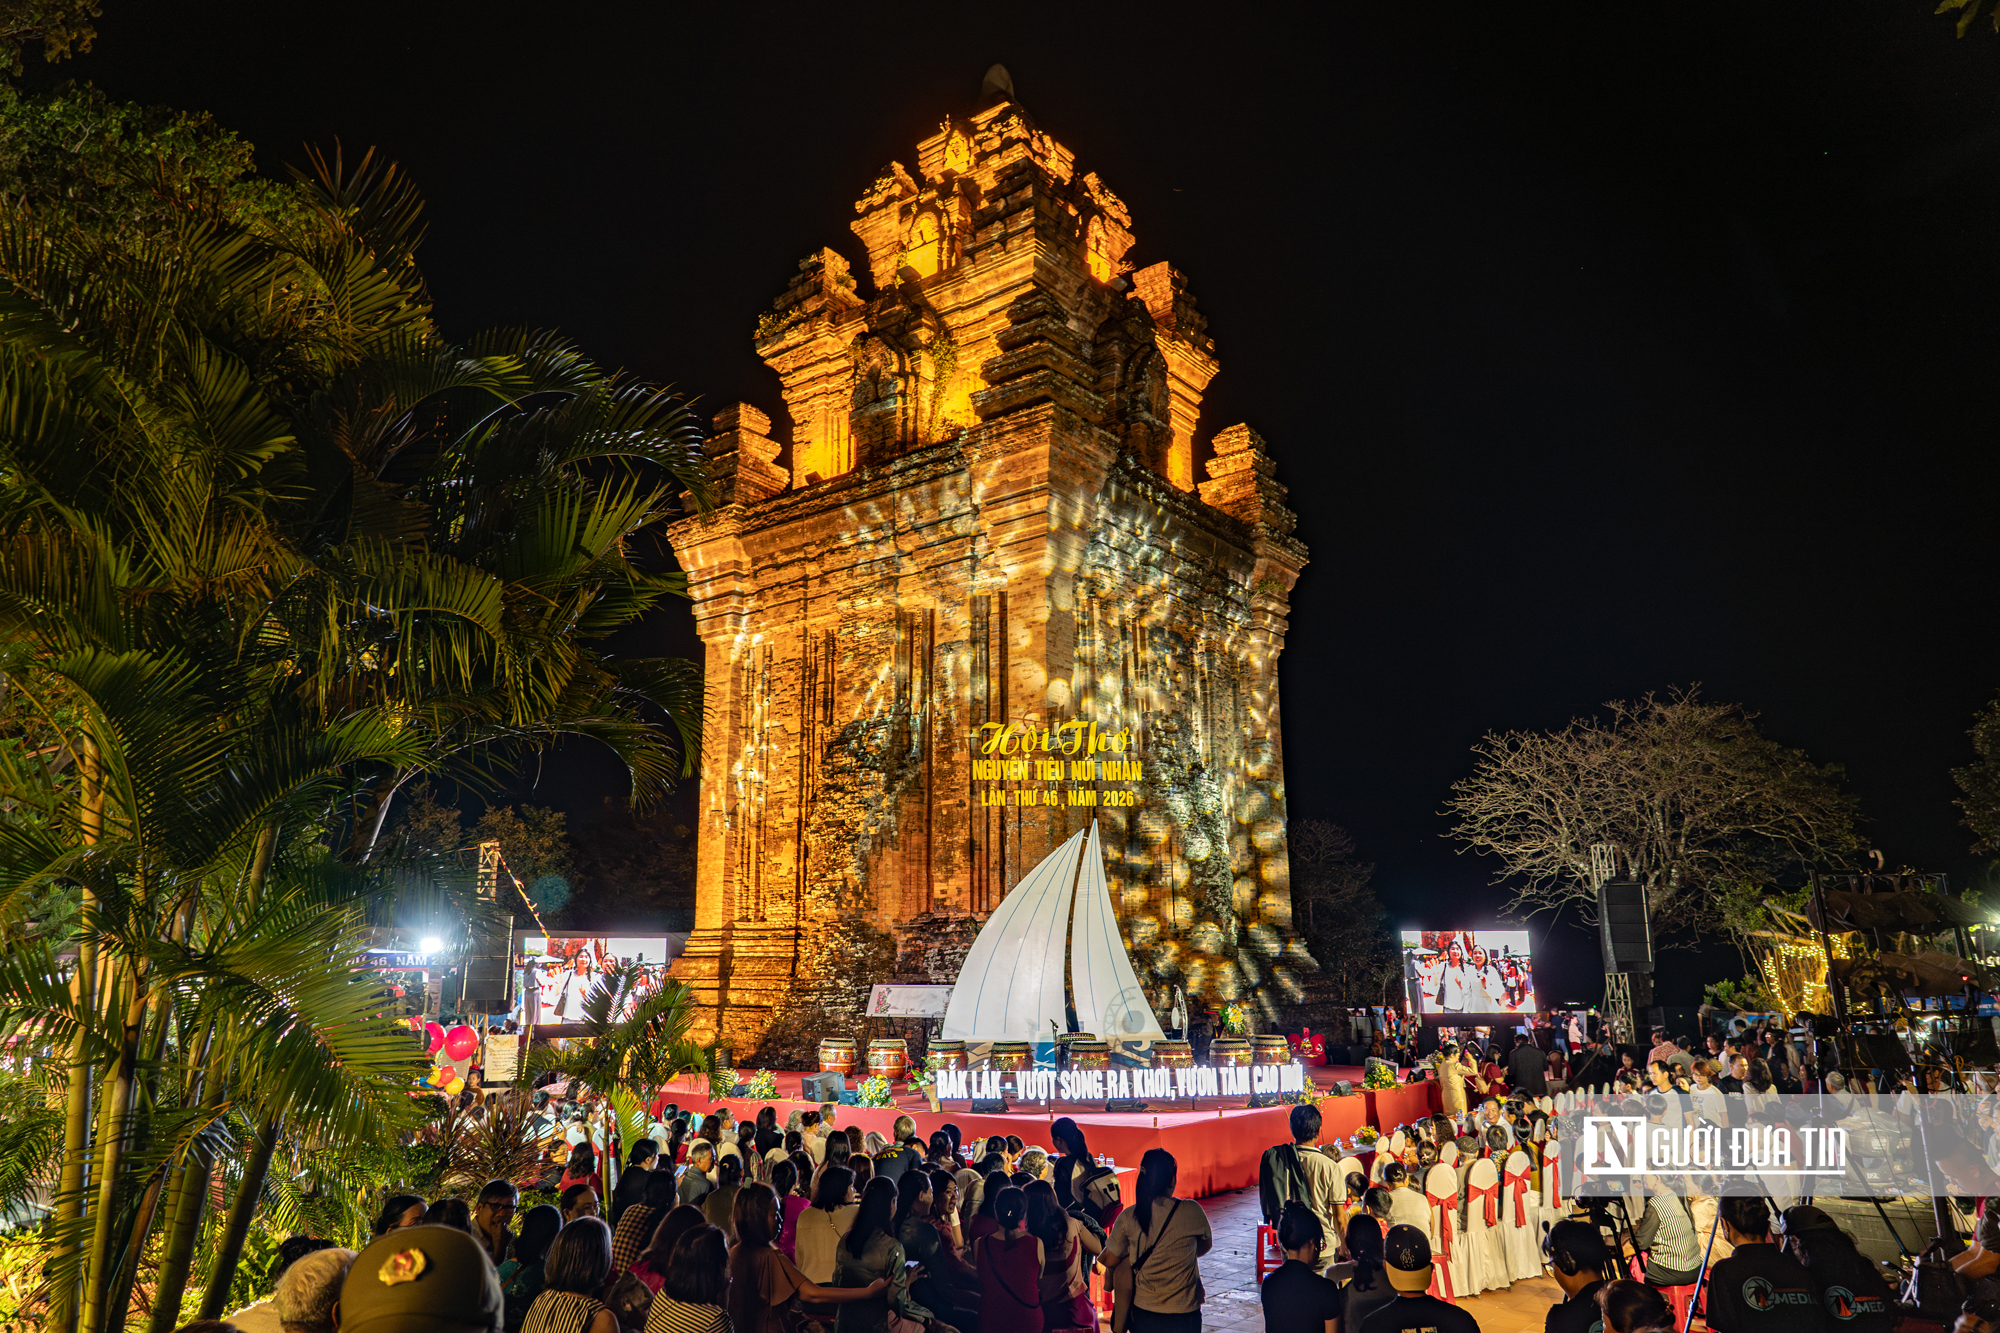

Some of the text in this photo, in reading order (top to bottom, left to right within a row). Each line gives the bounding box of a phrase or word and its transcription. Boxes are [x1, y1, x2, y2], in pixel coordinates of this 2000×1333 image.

[980, 721, 1132, 758] Hội Thơ
[973, 756, 1142, 785] NGUYÊN TIÊU NÚI NHẠN
[981, 784, 1006, 807] LẦN
[1013, 785, 1038, 807] THỨ
[1068, 786, 1097, 807] NĂM
[1103, 790, 1134, 807] 2026
[396, 954, 427, 966] NĂM
[431, 956, 456, 966] 202
[936, 1059, 968, 1099] ĐẮK
[972, 1059, 1002, 1099] LẮK
[1016, 1068, 1057, 1106] VƯỢT
[1060, 1064, 1103, 1100] SÓNG
[1107, 1070, 1130, 1099] RA
[1220, 1056, 1250, 1096] TẦM
[1253, 1064, 1279, 1094] CAO
[1280, 1057, 1303, 1093] MỚI
[1856, 1301, 1885, 1313] MED
